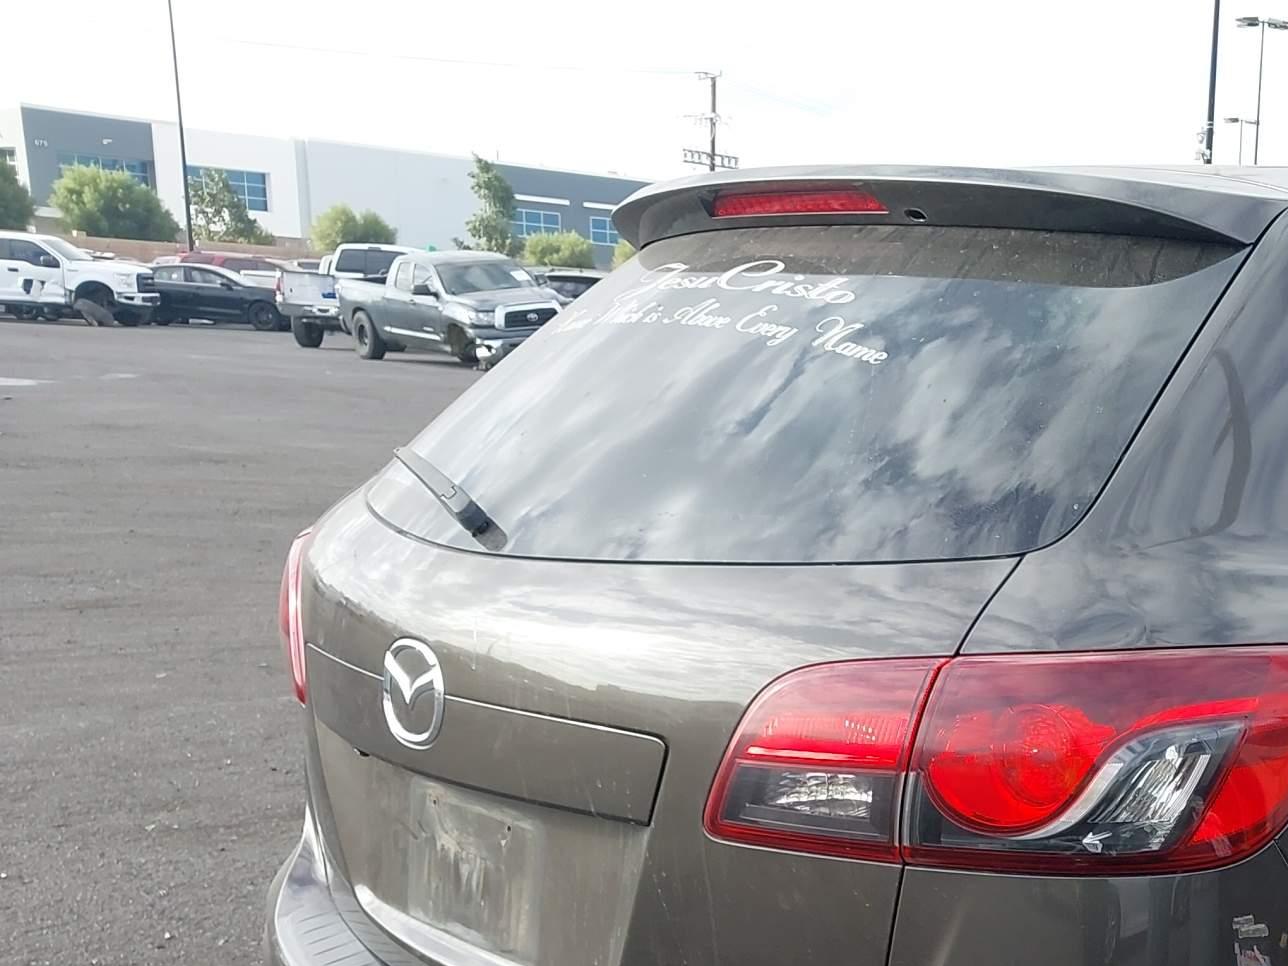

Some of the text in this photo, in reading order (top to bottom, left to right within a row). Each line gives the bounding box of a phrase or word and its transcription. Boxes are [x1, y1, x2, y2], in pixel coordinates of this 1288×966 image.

[662, 298, 731, 329] Above
[735, 304, 799, 347] Every
[811, 316, 889, 365] Name
